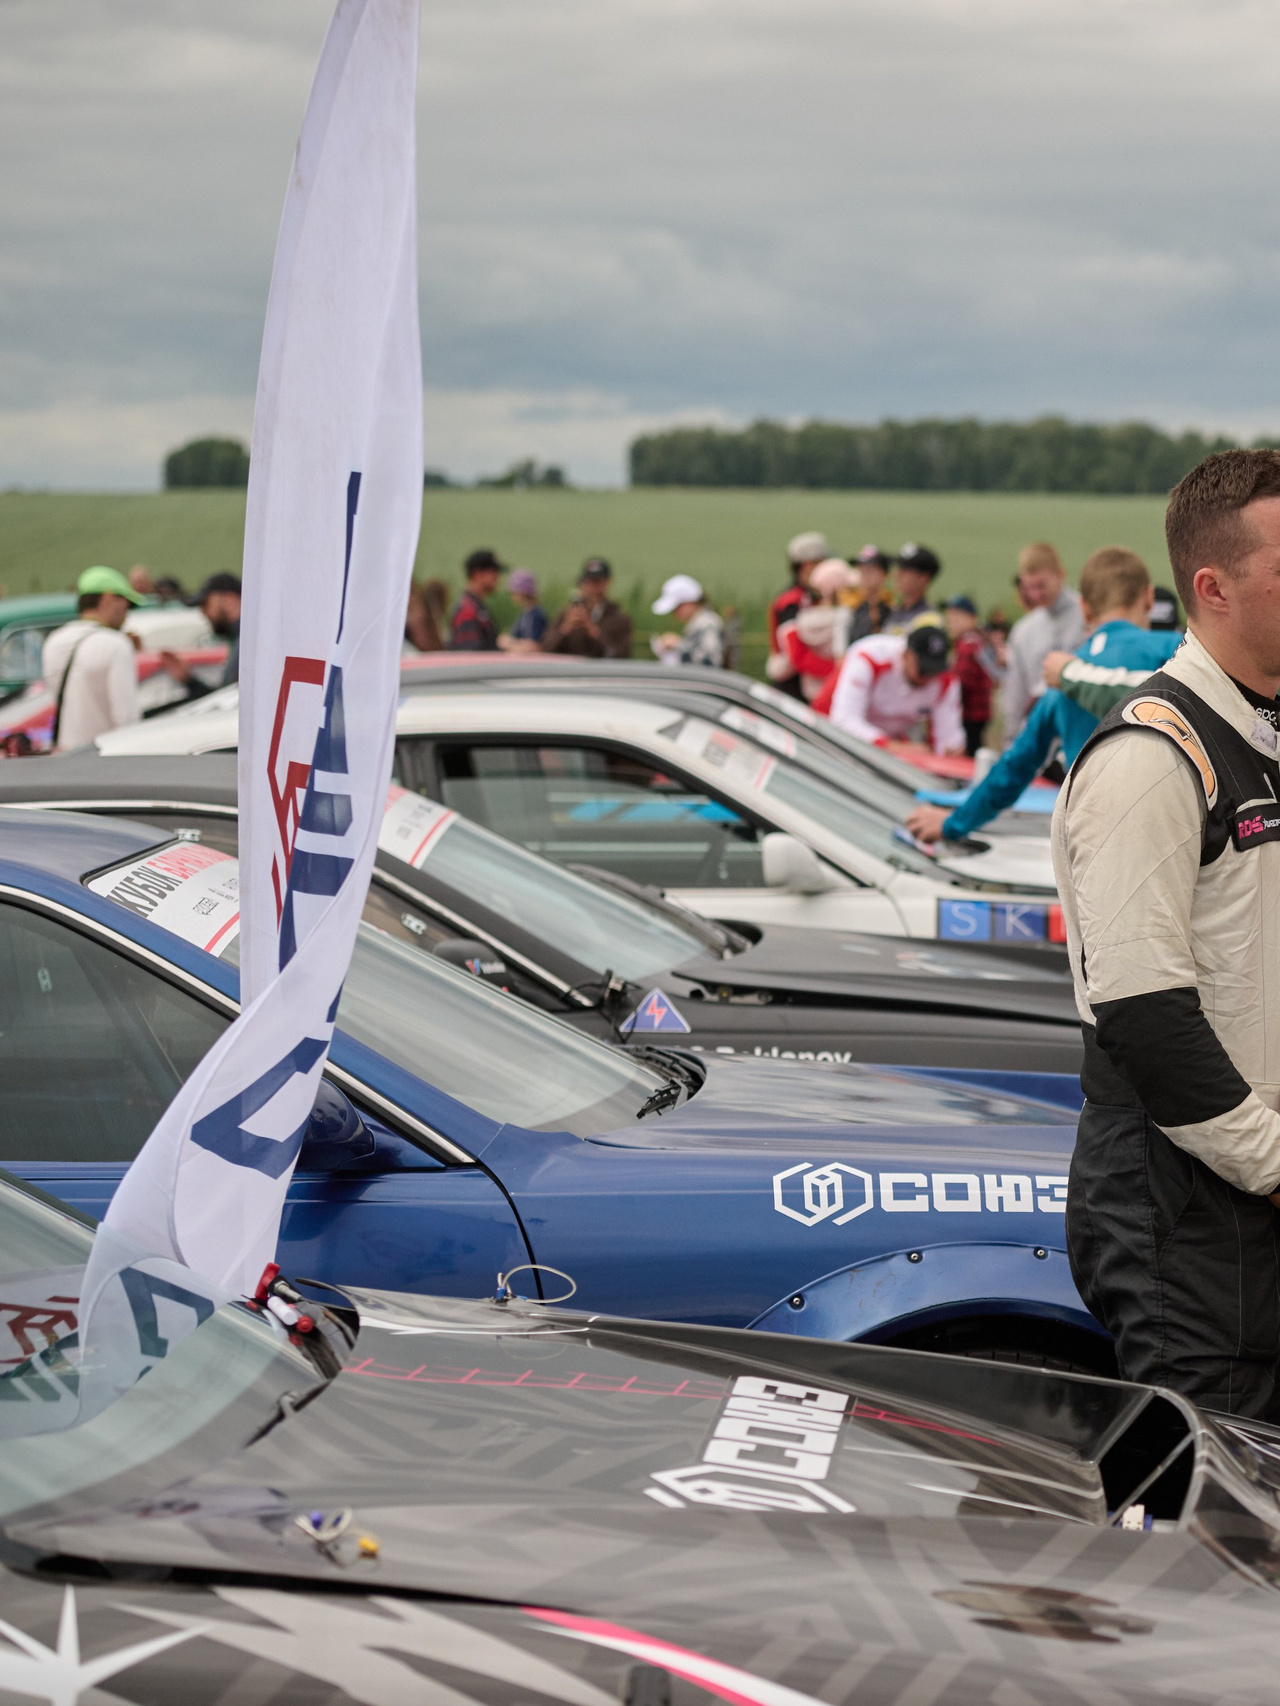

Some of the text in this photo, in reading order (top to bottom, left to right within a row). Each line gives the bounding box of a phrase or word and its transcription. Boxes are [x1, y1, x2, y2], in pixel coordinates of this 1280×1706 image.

[1238, 815, 1264, 839] RDS
[106, 864, 183, 919] КУБОК
[703, 1376, 850, 1480] СОЮЗ
